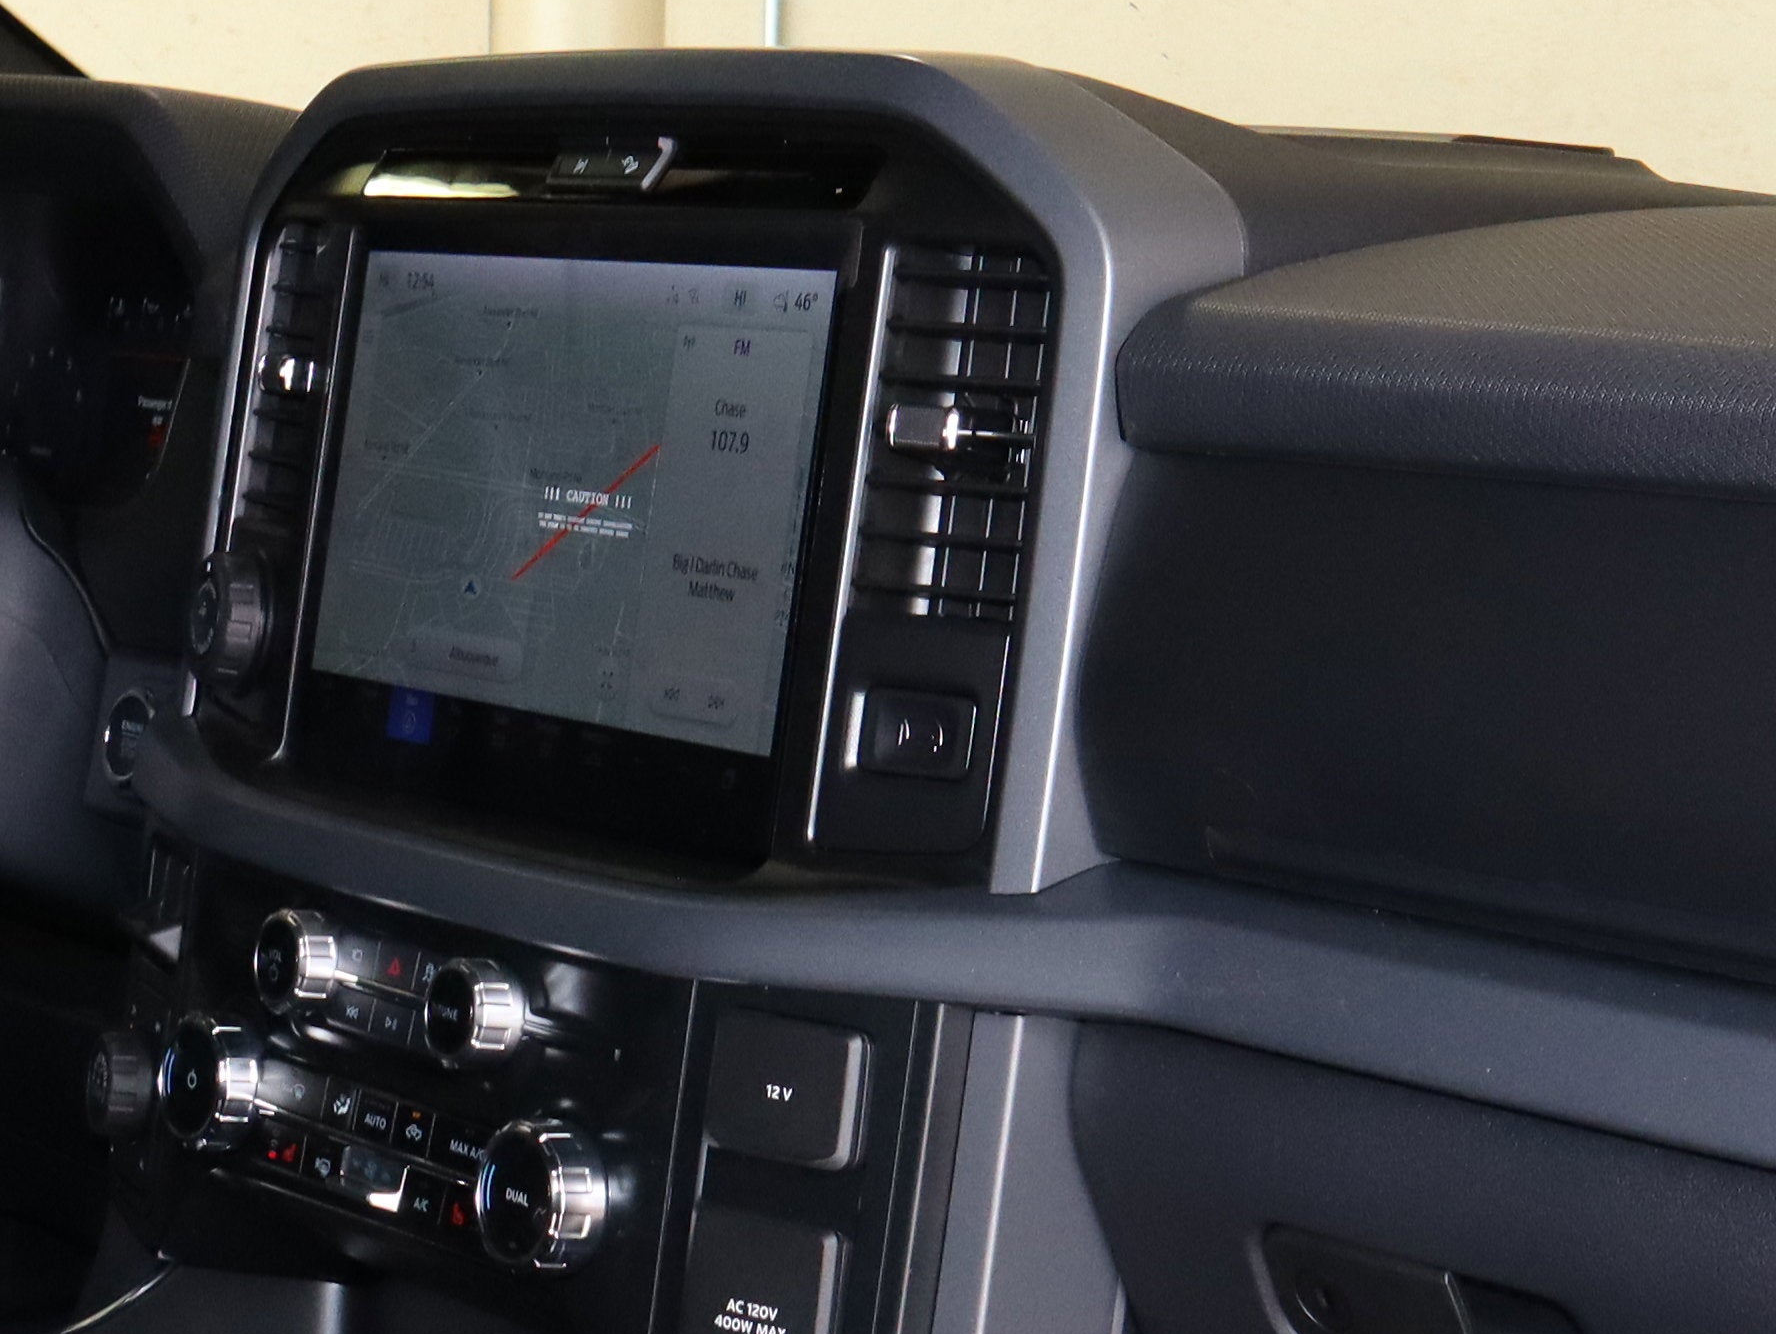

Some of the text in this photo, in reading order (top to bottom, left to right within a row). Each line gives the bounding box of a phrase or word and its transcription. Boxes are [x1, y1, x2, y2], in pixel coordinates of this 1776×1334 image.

[733, 338, 751, 355] FM
[714, 398, 747, 418] Chase
[710, 429, 750, 454] 107.9
[565, 488, 609, 507] CAUTION
[726, 560, 759, 581] Chase
[687, 580, 736, 602] Matthew
[766, 1084, 793, 1101] 12 V
[364, 1113, 387, 1130] AUTO
[449, 1139, 470, 1157] MAX
[413, 1198, 430, 1213] A/C
[505, 1187, 529, 1208] DUAL
[726, 1298, 779, 1322] AC 120V
[714, 1314, 752, 1334] 400W
